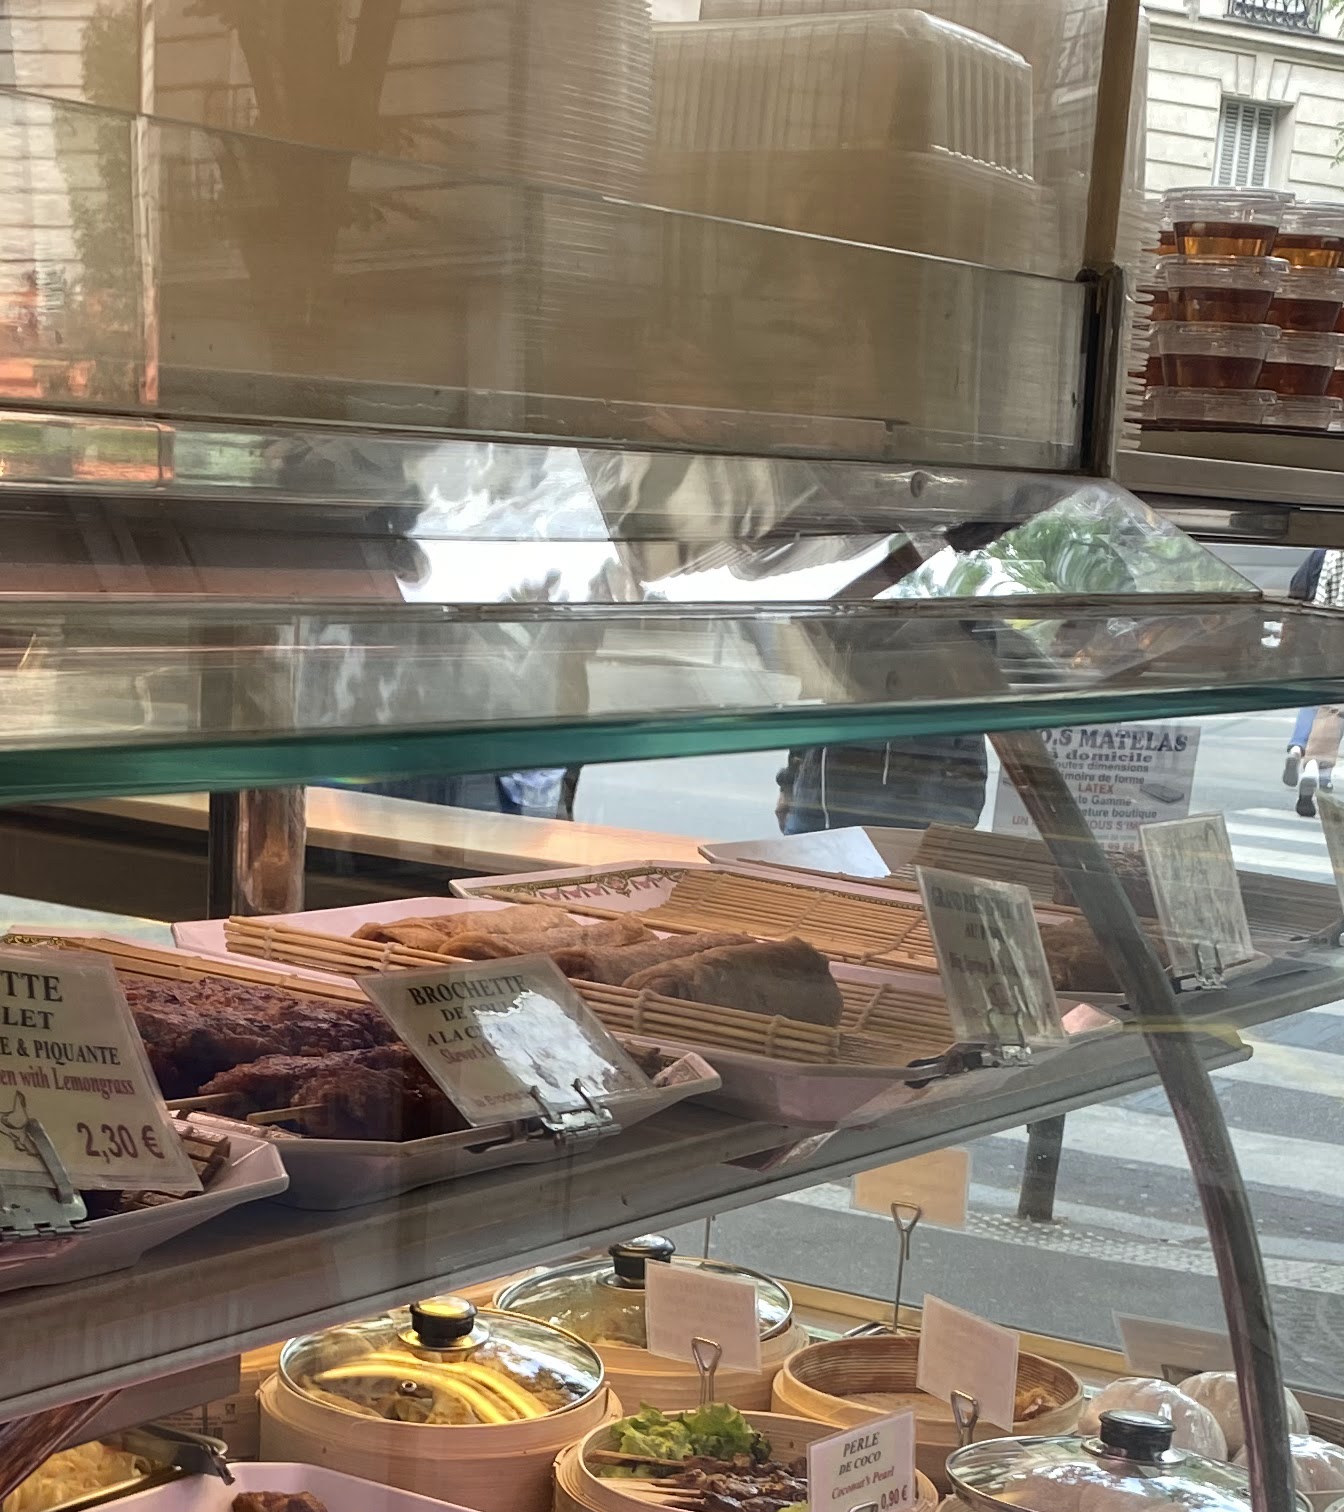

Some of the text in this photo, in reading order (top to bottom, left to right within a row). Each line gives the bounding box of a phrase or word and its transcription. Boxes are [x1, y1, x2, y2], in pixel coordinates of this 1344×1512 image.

[1079, 729, 1188, 752] MATELAS
[1057, 762, 1149, 772] outes dimensions
[1066, 750, 1153, 763] domicile
[1078, 782, 1115, 795] LATEX
[1112, 808, 1158, 820] boutique
[408, 975, 528, 1006] BROCHETTE
[440, 1006, 468, 1022] DE
[17, 1038, 30, 1057] &
[34, 1040, 121, 1066] PIQUANTE
[19, 1065, 50, 1089] with
[51, 1067, 136, 1100] Lemongrass
[76, 1122, 165, 1164] 2,30 €
[843, 1432, 880, 1458] PERLE
[838, 1450, 882, 1476] DE COCO
[872, 1466, 895, 1484] Pearl
